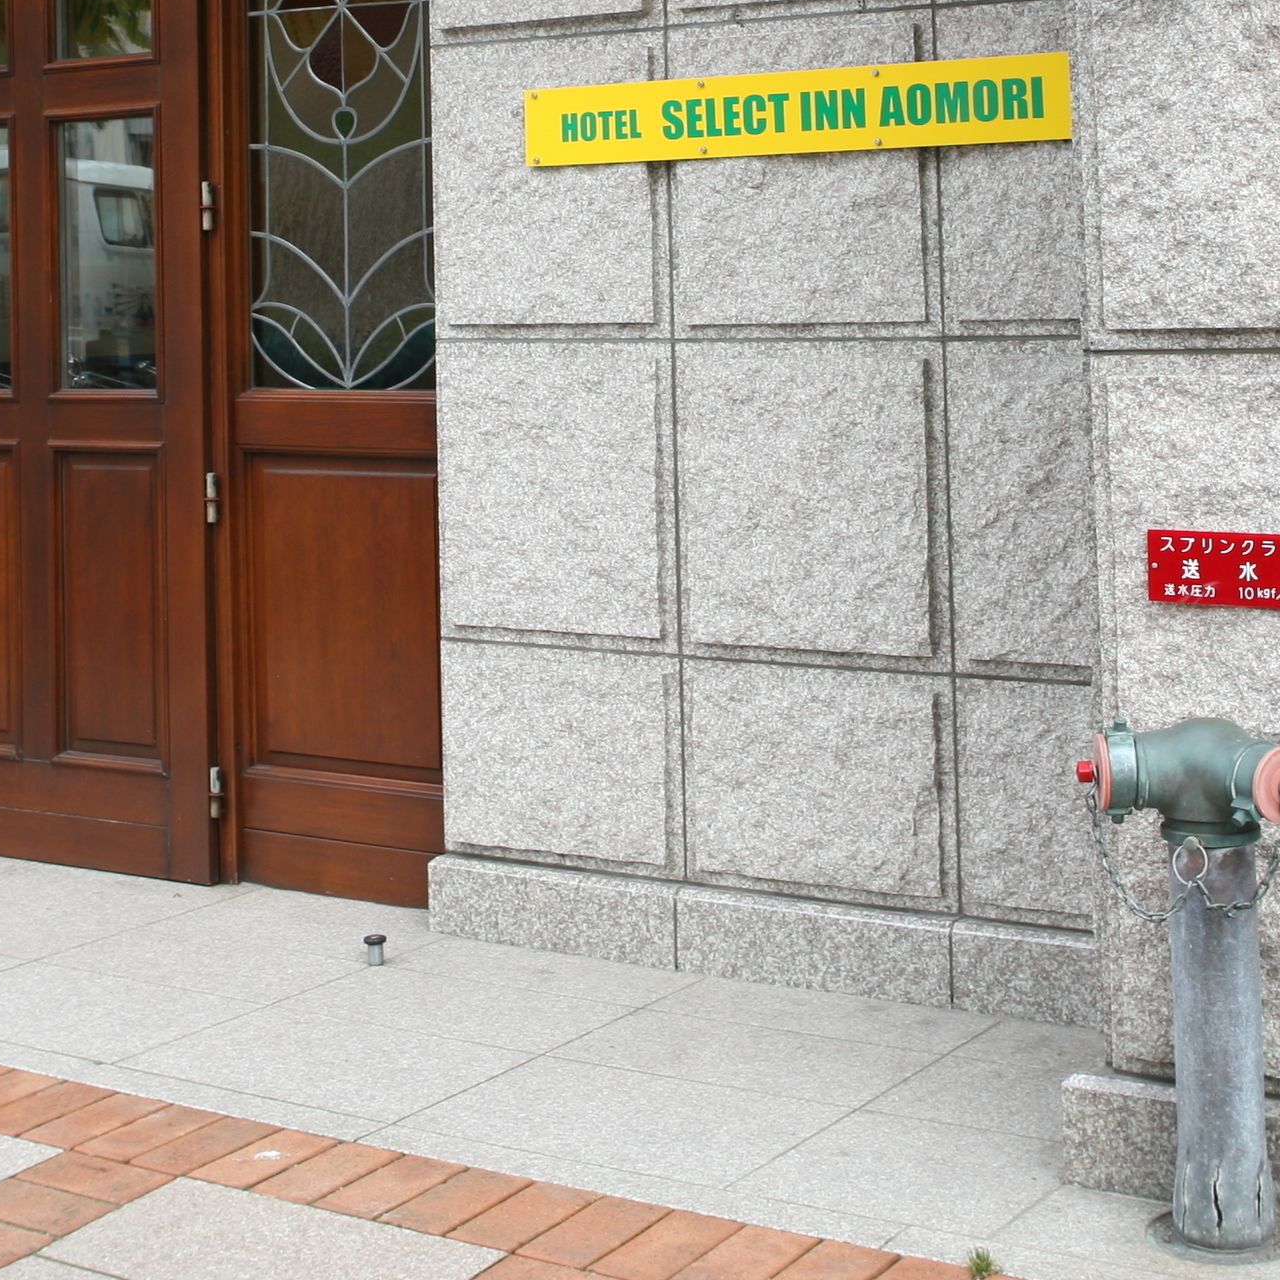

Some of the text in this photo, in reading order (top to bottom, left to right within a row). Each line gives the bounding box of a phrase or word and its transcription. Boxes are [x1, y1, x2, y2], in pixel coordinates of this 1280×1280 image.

[560, 75, 1045, 143] HOTEL SELECT INN AOMORI
[1163, 583, 1216, 598] 送水圧力
